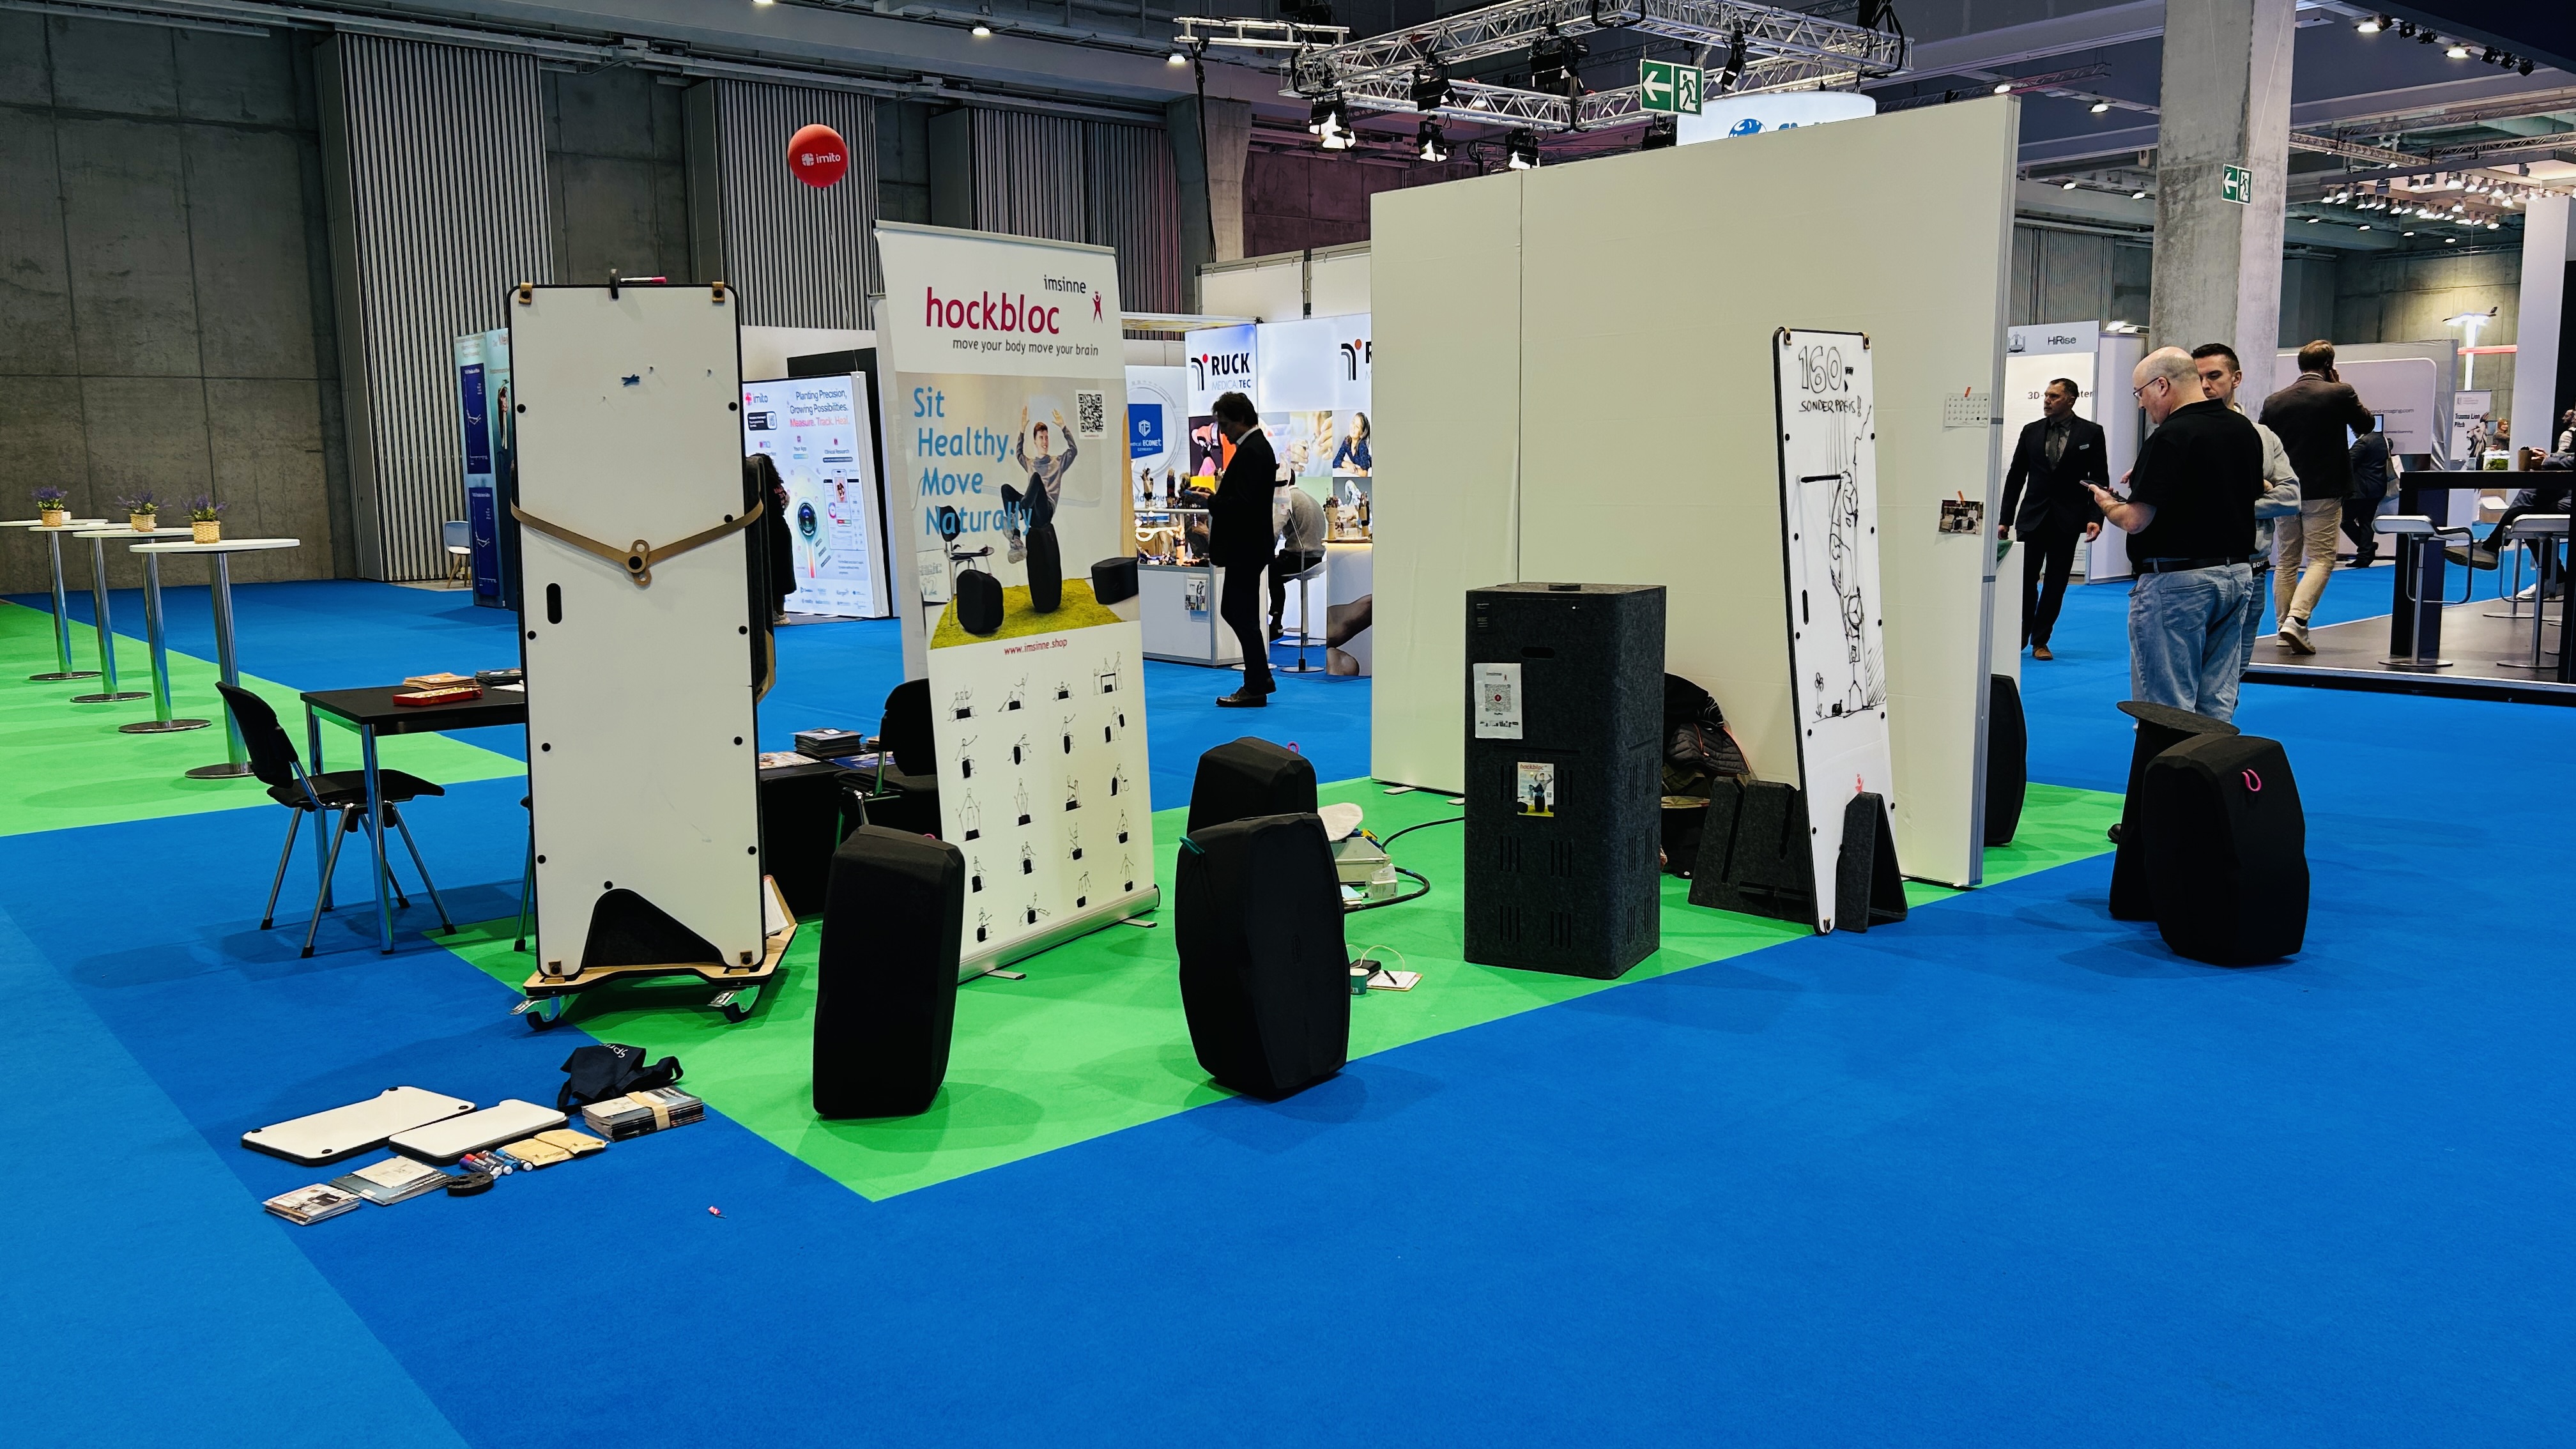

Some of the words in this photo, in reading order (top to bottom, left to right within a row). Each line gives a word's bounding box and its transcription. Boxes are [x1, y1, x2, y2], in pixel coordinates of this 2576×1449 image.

[816, 153, 841, 164] imito
[1043, 274, 1087, 294] imsinne
[926, 286, 1060, 334] hockbloc
[953, 339, 979, 351] move
[981, 341, 1002, 353] your
[1005, 339, 1026, 355] body
[1028, 344, 1054, 354] move
[1055, 344, 1073, 356] your
[1075, 343, 1099, 356] brain
[1211, 352, 1250, 376] RUCK
[796, 391, 819, 402] Planting
[819, 390, 847, 400] Precision,
[914, 387, 946, 418] Sit
[790, 405, 813, 416] Growing
[813, 402, 849, 413] Possibilities.
[790, 418, 816, 427] Measure.
[816, 417, 834, 426] Track.
[918, 426, 1015, 463] Healthy.
[921, 467, 984, 496] Move
[926, 501, 1032, 535] Naturally
[1004, 638, 1068, 656] www.imsinne.shop
